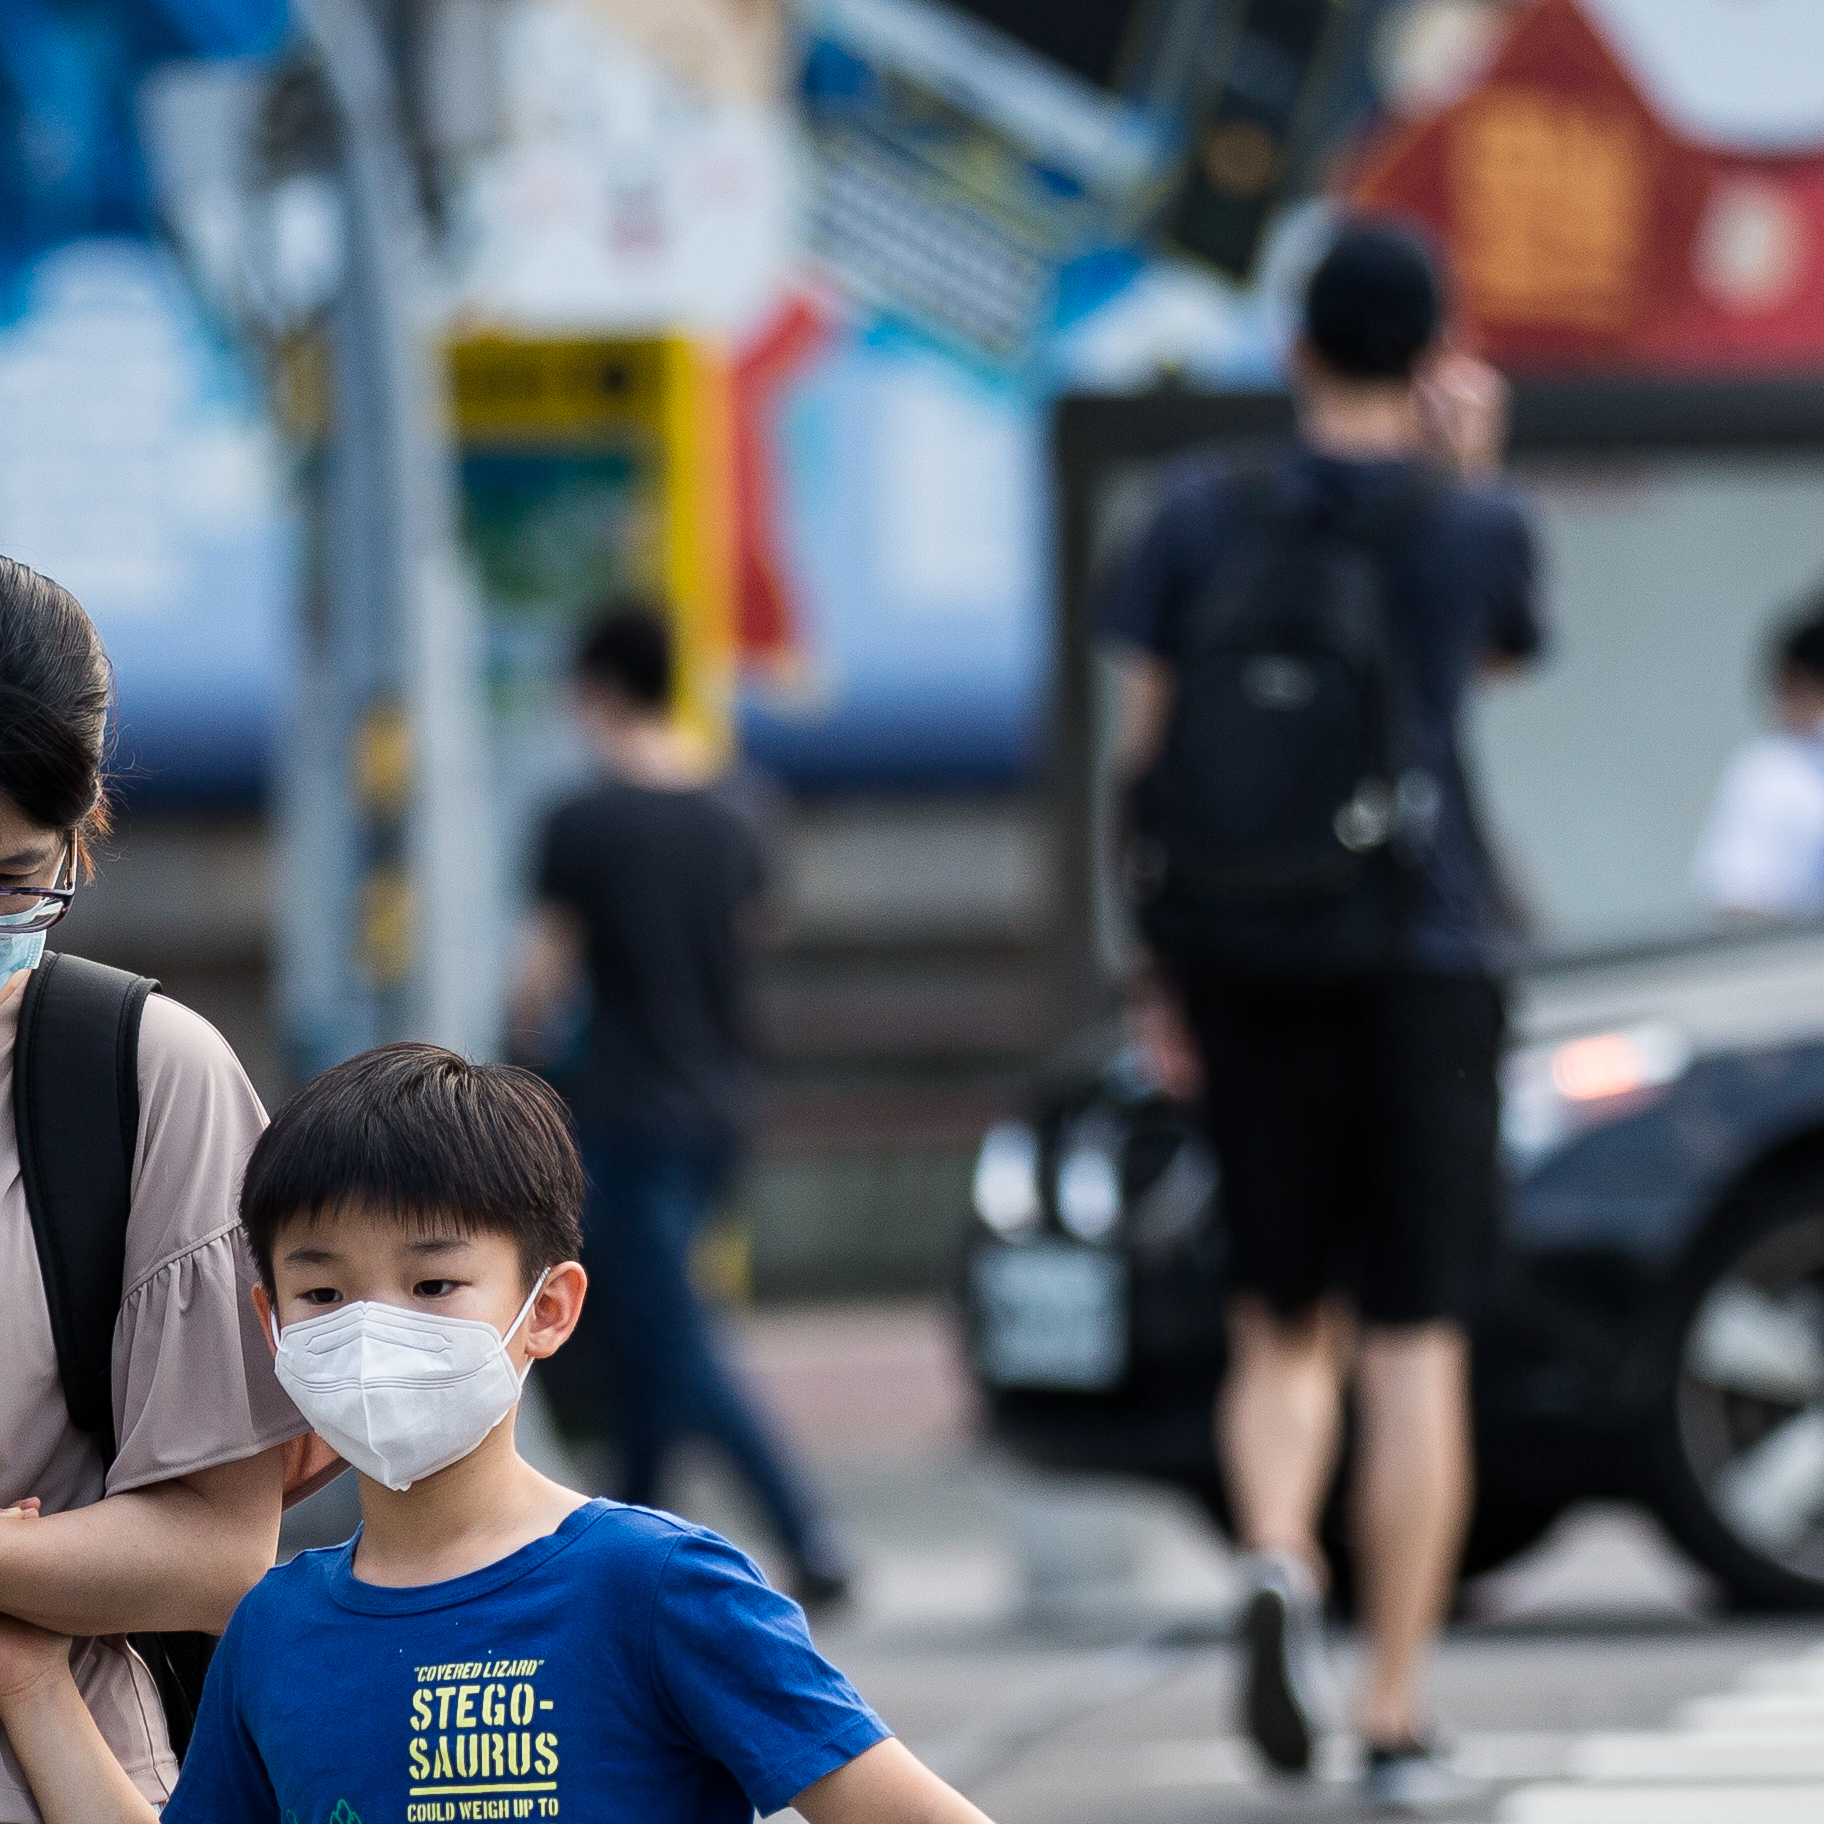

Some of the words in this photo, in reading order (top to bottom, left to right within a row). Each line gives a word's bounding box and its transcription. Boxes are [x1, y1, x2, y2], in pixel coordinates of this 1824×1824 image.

[409, 1682, 554, 1732] STEGO-
[408, 1731, 559, 1780] SAURUS
[407, 1801, 456, 1823] COULD
[458, 1799, 510, 1820] WEIGH
[513, 1798, 534, 1818] UP
[537, 1797, 559, 1817] TO
